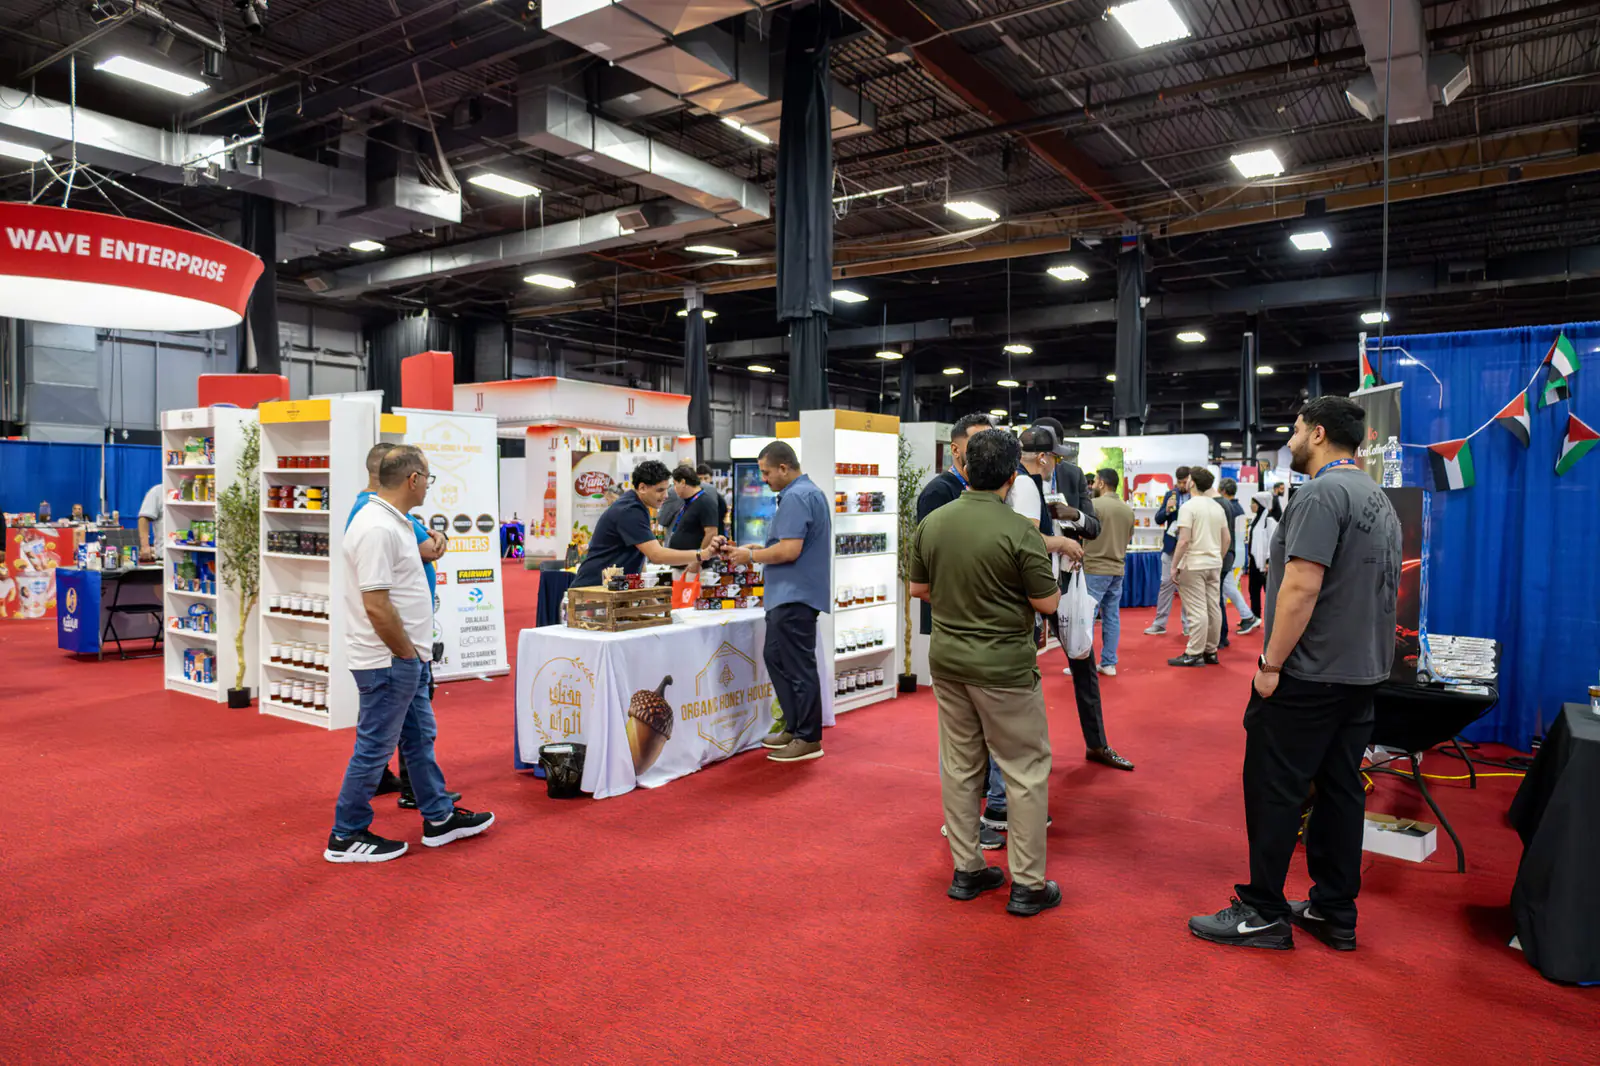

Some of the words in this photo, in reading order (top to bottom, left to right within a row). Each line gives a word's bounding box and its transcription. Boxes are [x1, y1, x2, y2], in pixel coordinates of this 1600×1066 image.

[6, 227, 90, 256] WAVE
[100, 237, 227, 282] ENTERPRISE
[458, 569, 493, 579] FAIRWAY
[460, 624, 496, 633] SUPERMARKETS
[461, 659, 497, 668] SUPERMARKETS
[720, 689, 745, 710] HONEY
